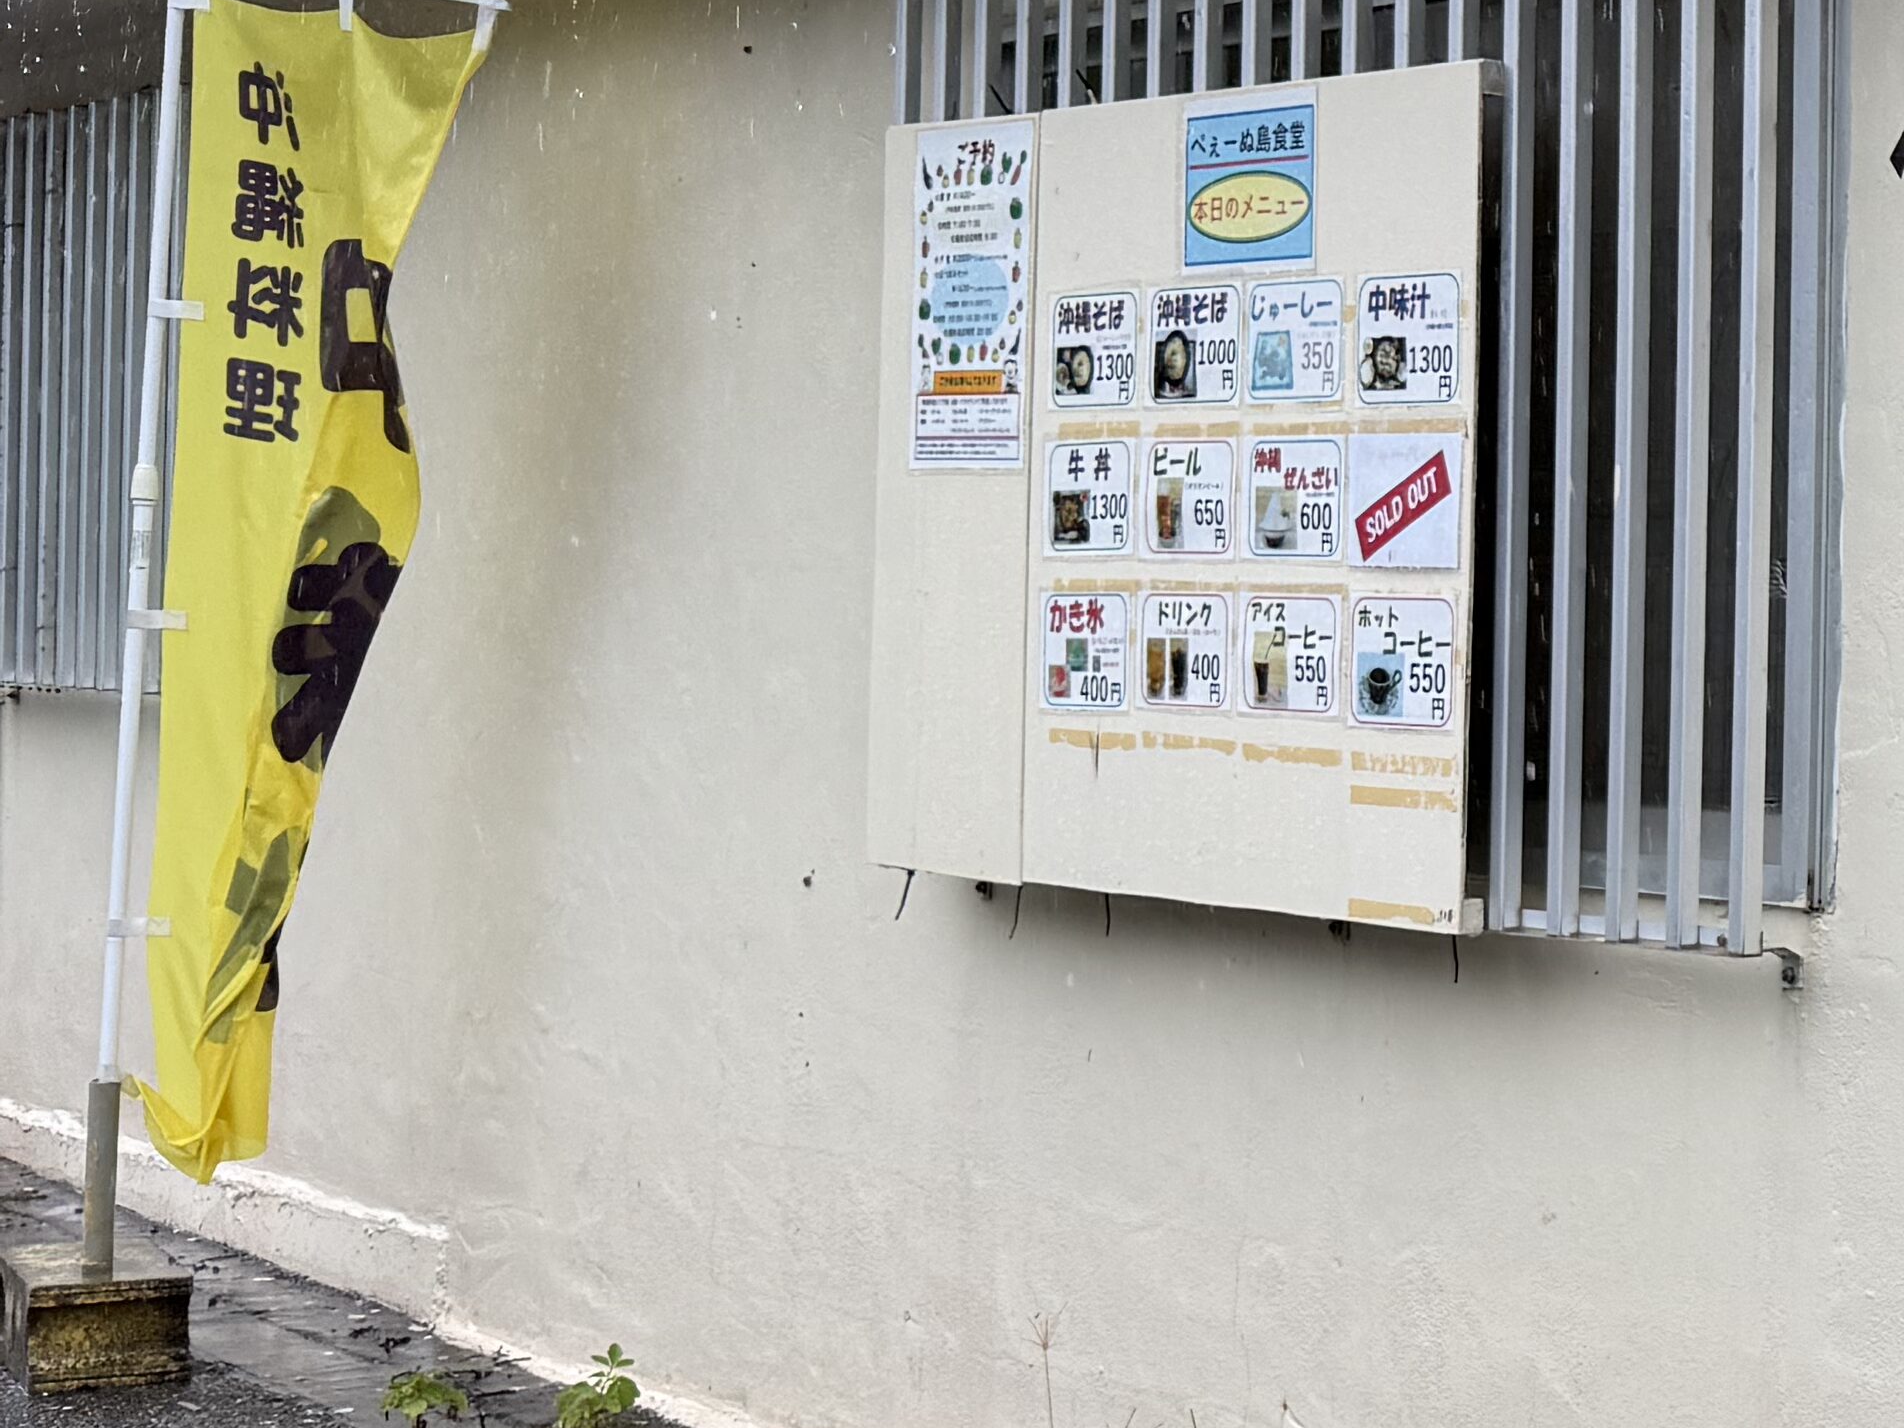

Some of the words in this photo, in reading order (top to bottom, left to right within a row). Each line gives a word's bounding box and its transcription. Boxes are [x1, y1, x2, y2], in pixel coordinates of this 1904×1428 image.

[1194, 195, 1304, 223] 本日のメニュー
[1157, 292, 1228, 327] 沖縄そば
[1251, 291, 1333, 321] じゅーしー
[1368, 281, 1431, 322] 中味汁
[1058, 300, 1124, 334] 沖縄そば
[1198, 339, 1236, 365] 1000
[1302, 341, 1333, 370] 350
[1409, 345, 1451, 373] 1300
[1096, 353, 1133, 381] 1300
[1154, 447, 1201, 476] ビール
[1283, 466, 1338, 491] ぜんざい
[1091, 493, 1127, 520] 1300
[1194, 499, 1224, 526] 650
[1300, 503, 1332, 530] 600
[1364, 495, 1404, 544] SOLD
[1407, 467, 1437, 510] OUT
[1049, 598, 1105, 635] かき氷
[1158, 601, 1212, 627] ドリンク
[1252, 602, 1286, 622] アイス
[1358, 605, 1399, 628] ホット
[1272, 624, 1333, 649] コーヒー
[1382, 630, 1452, 658] コーヒー
[1191, 654, 1220, 681] 400
[1294, 655, 1327, 682] 550
[1409, 663, 1446, 693] 550
